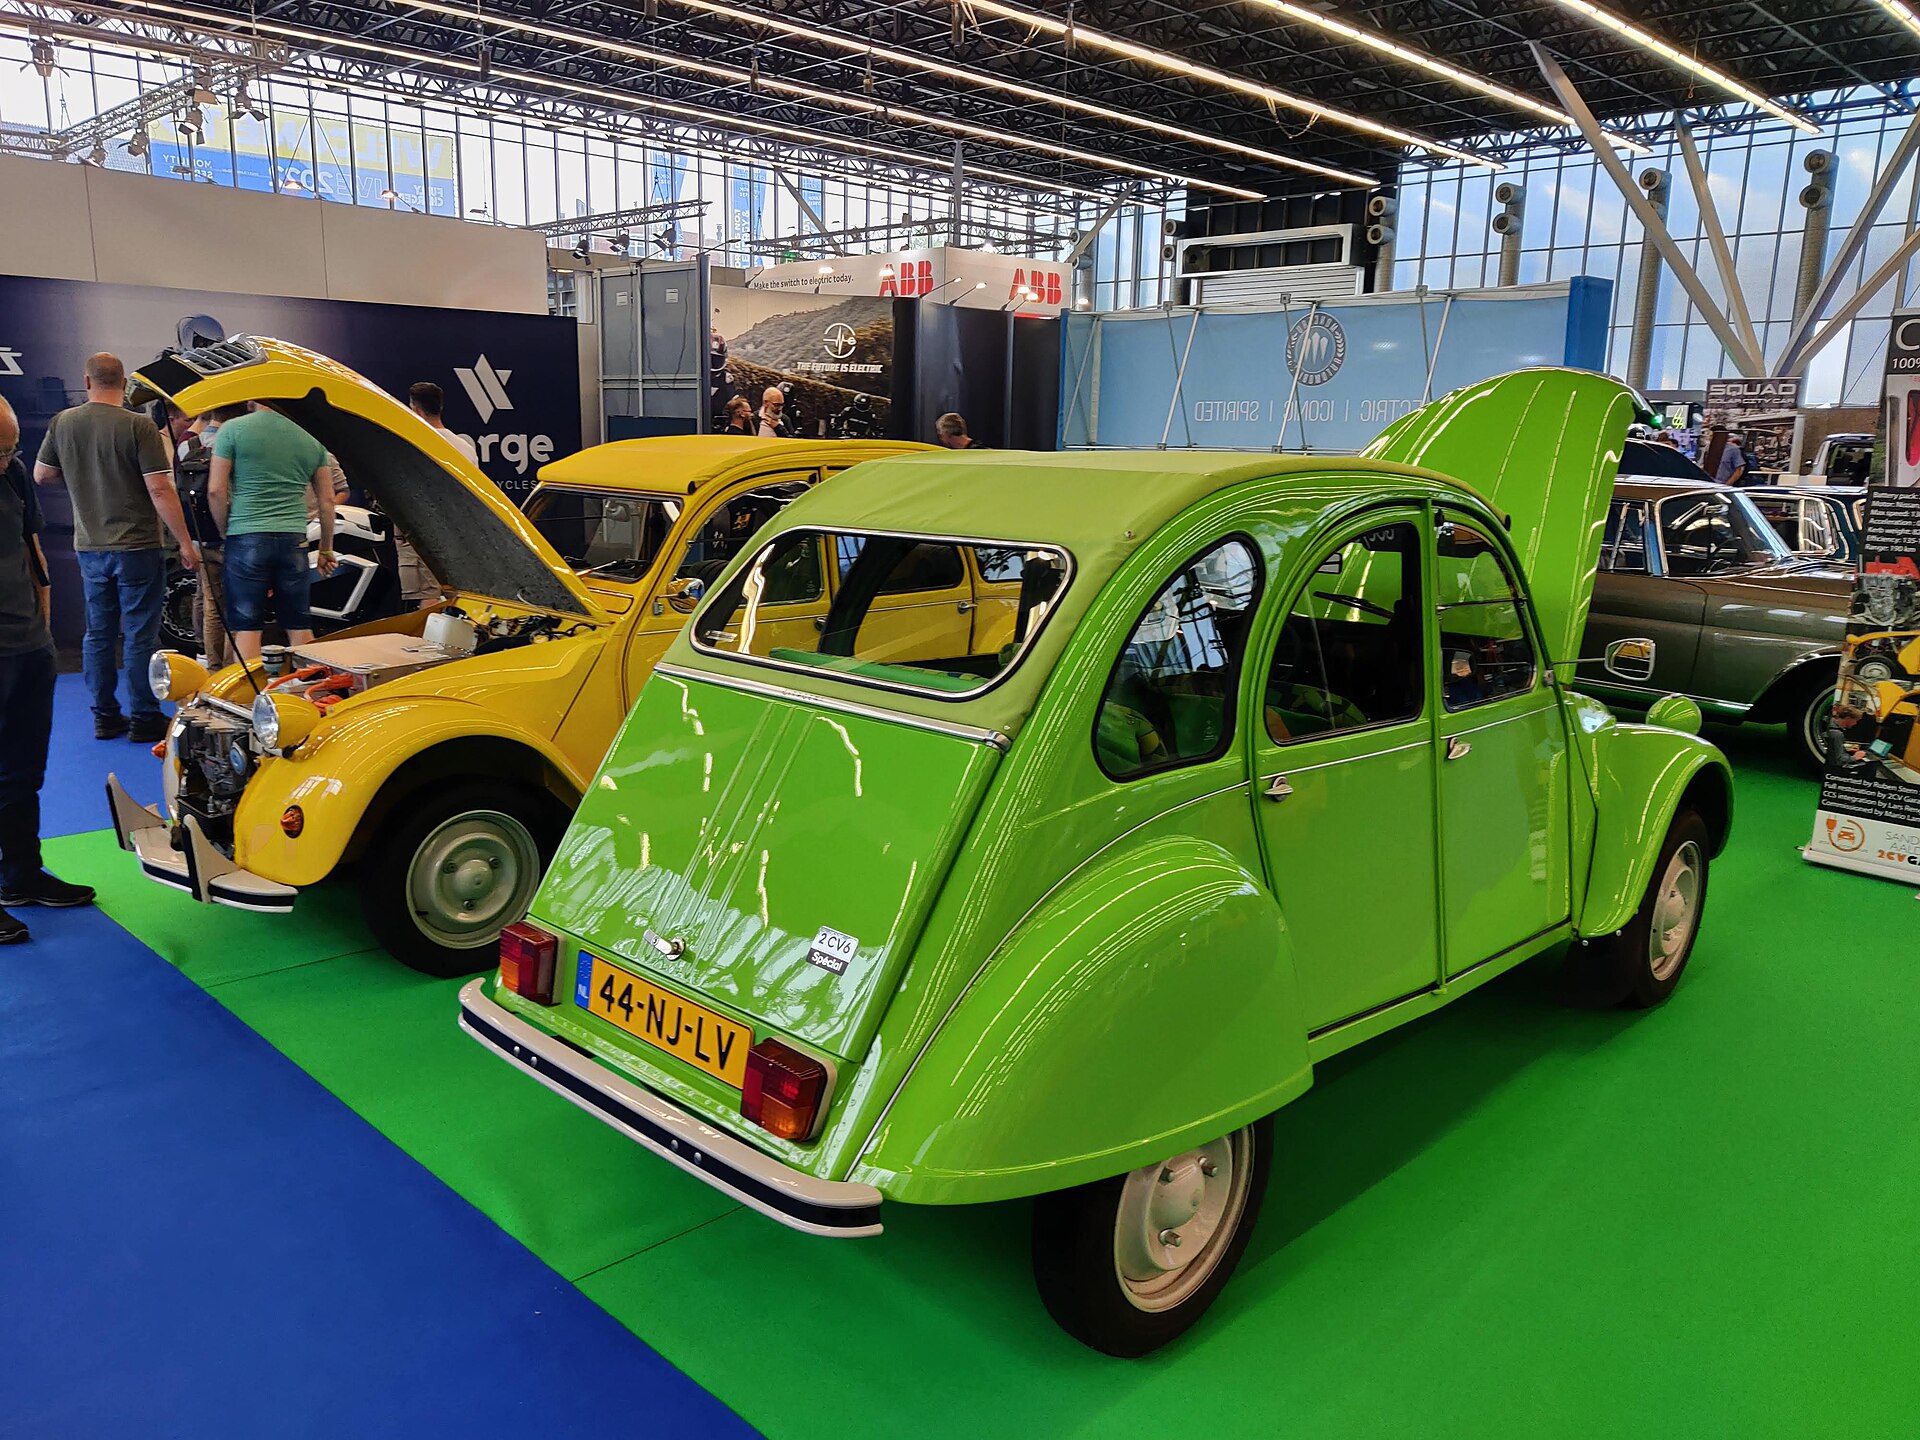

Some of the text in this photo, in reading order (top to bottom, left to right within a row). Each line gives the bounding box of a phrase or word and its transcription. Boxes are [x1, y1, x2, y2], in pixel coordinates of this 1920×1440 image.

[770, 280, 779, 288] the
[781, 278, 800, 287] switch
[801, 278, 808, 286] to
[809, 275, 832, 285] electric
[833, 273, 854, 284] today.
[879, 260, 934, 297] ABB
[1008, 268, 1062, 305] ABB
[797, 362, 883, 373] THE FUTURE IS ELECTRIC
[1709, 383, 1796, 396] SQUAD
[497, 480, 537, 490] YCLES
[1863, 779, 1873, 788] by
[1877, 790, 1887, 799] by
[1878, 800, 1887, 808] by
[1874, 808, 1884, 816] by
[1877, 849, 1920, 866] 2CVG
[818, 932, 851, 954] 2CV6
[577, 983, 589, 999] NL
[599, 974, 736, 1070] 44-NJ-LV
